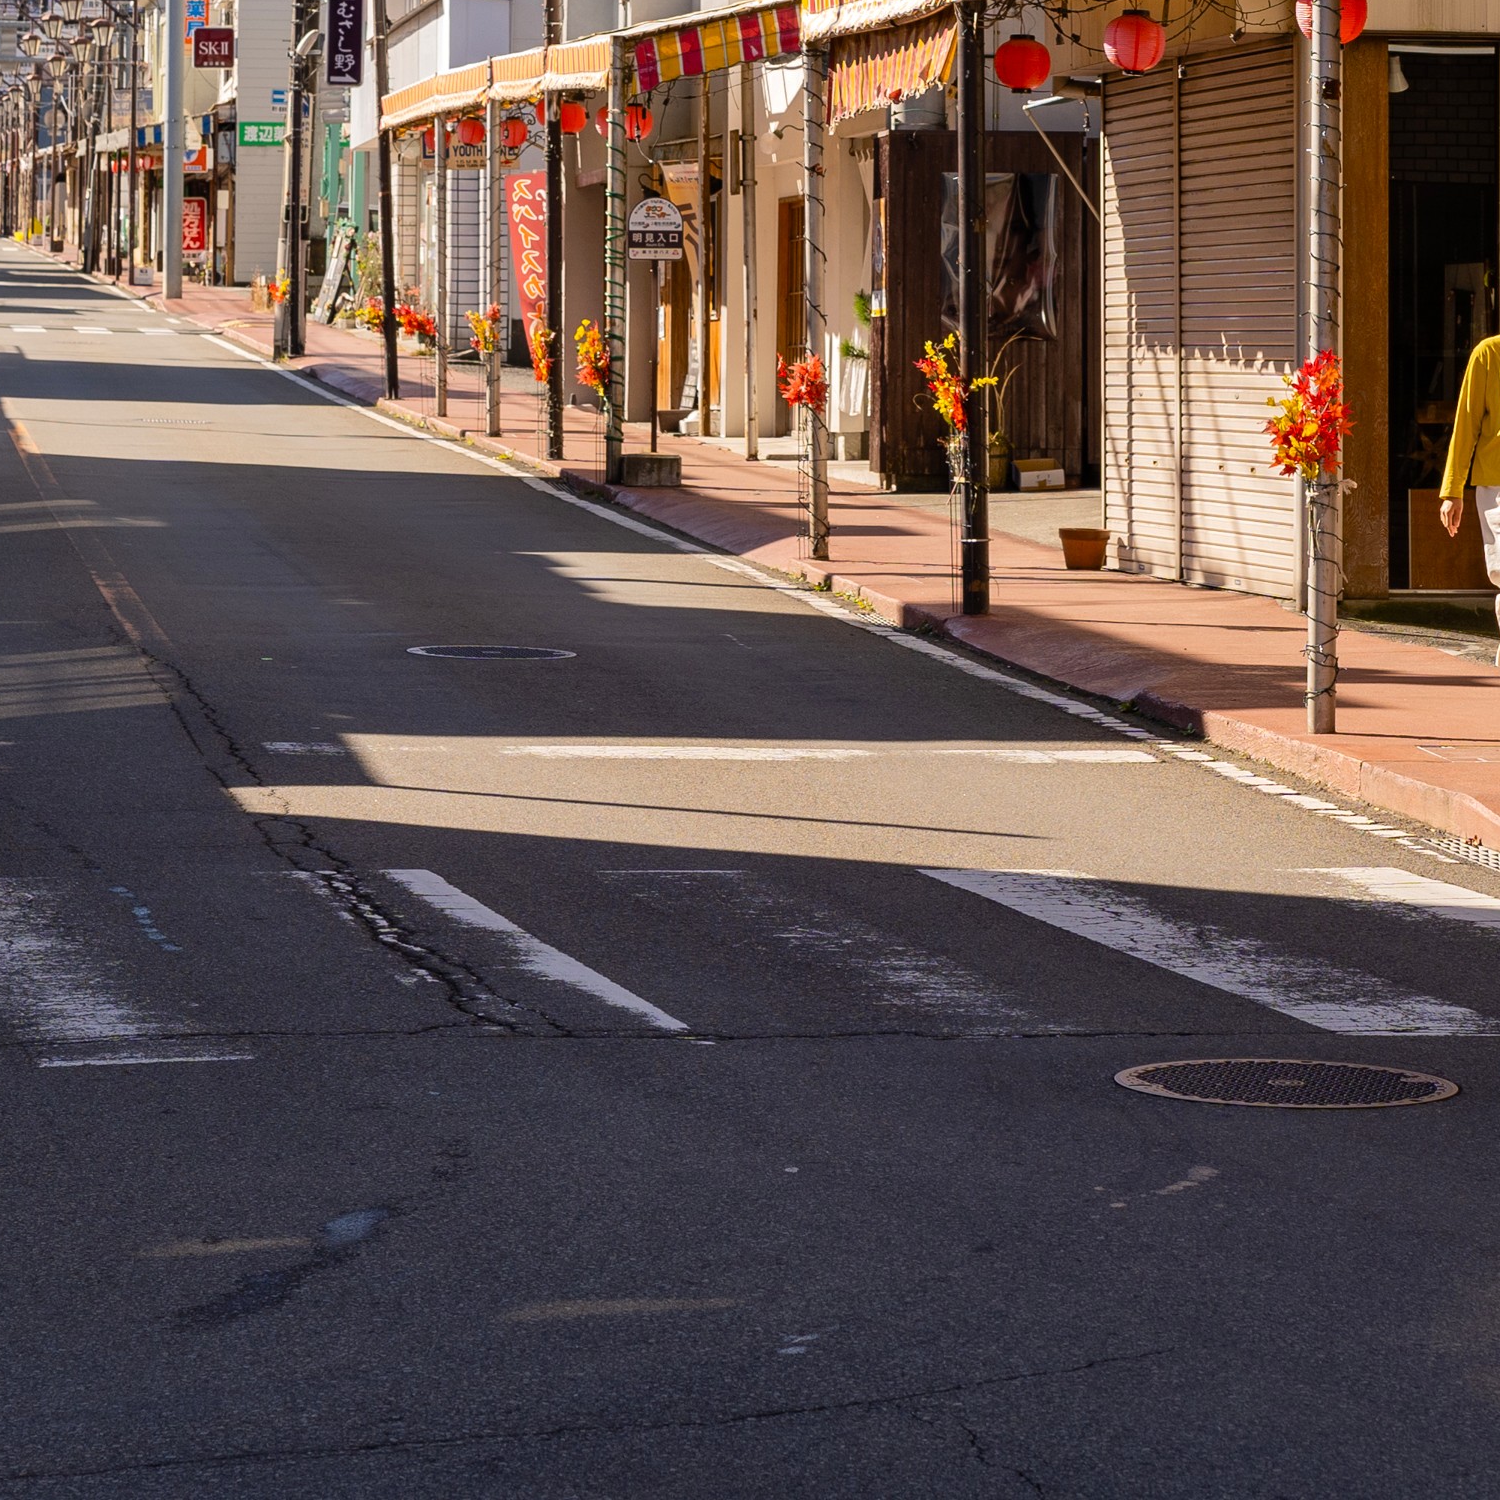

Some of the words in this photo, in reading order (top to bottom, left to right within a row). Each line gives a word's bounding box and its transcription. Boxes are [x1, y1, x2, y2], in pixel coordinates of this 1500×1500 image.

[334, 2, 355, 72] むさし野
[199, 41, 229, 55] SK-II
[452, 145, 482, 157] YOUTH
[632, 232, 678, 243] 明見入口
